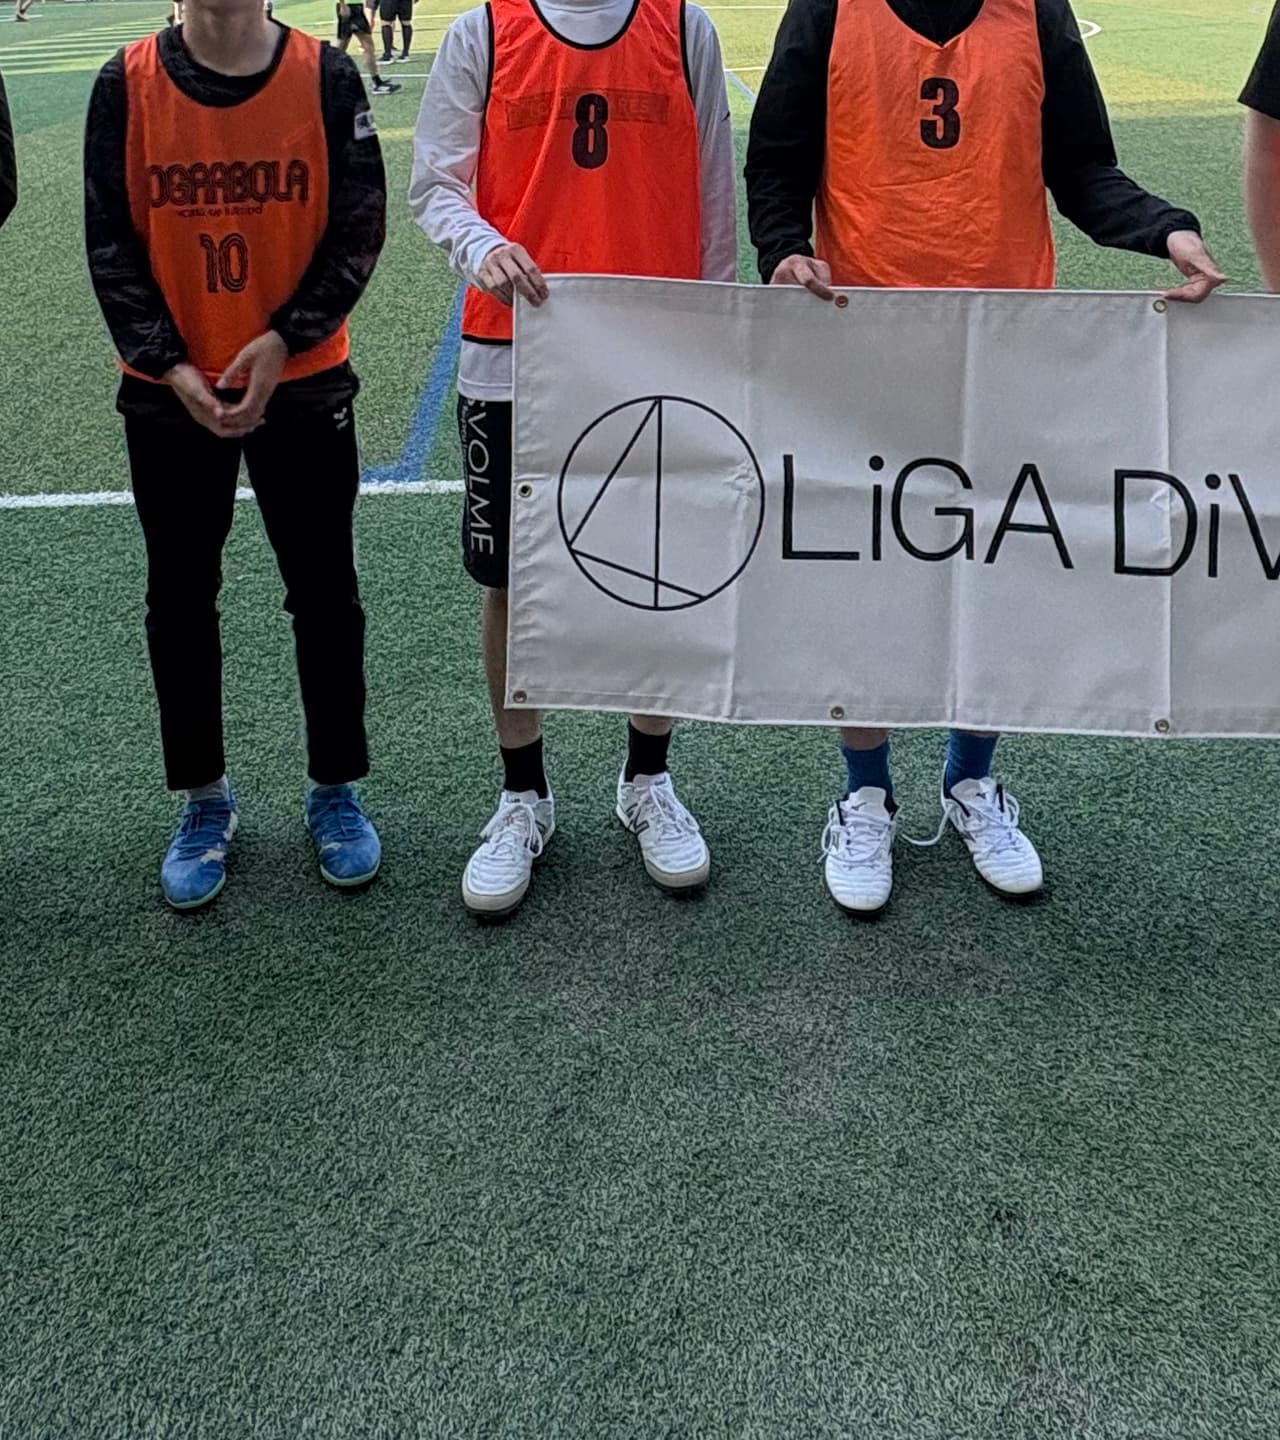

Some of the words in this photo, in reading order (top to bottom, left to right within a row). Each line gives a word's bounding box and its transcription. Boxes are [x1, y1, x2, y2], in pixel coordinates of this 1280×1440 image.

[572, 93, 609, 169] 8
[919, 77, 962, 149] 3
[199, 232, 249, 294] 10
[781, 453, 1075, 570] LiGA
